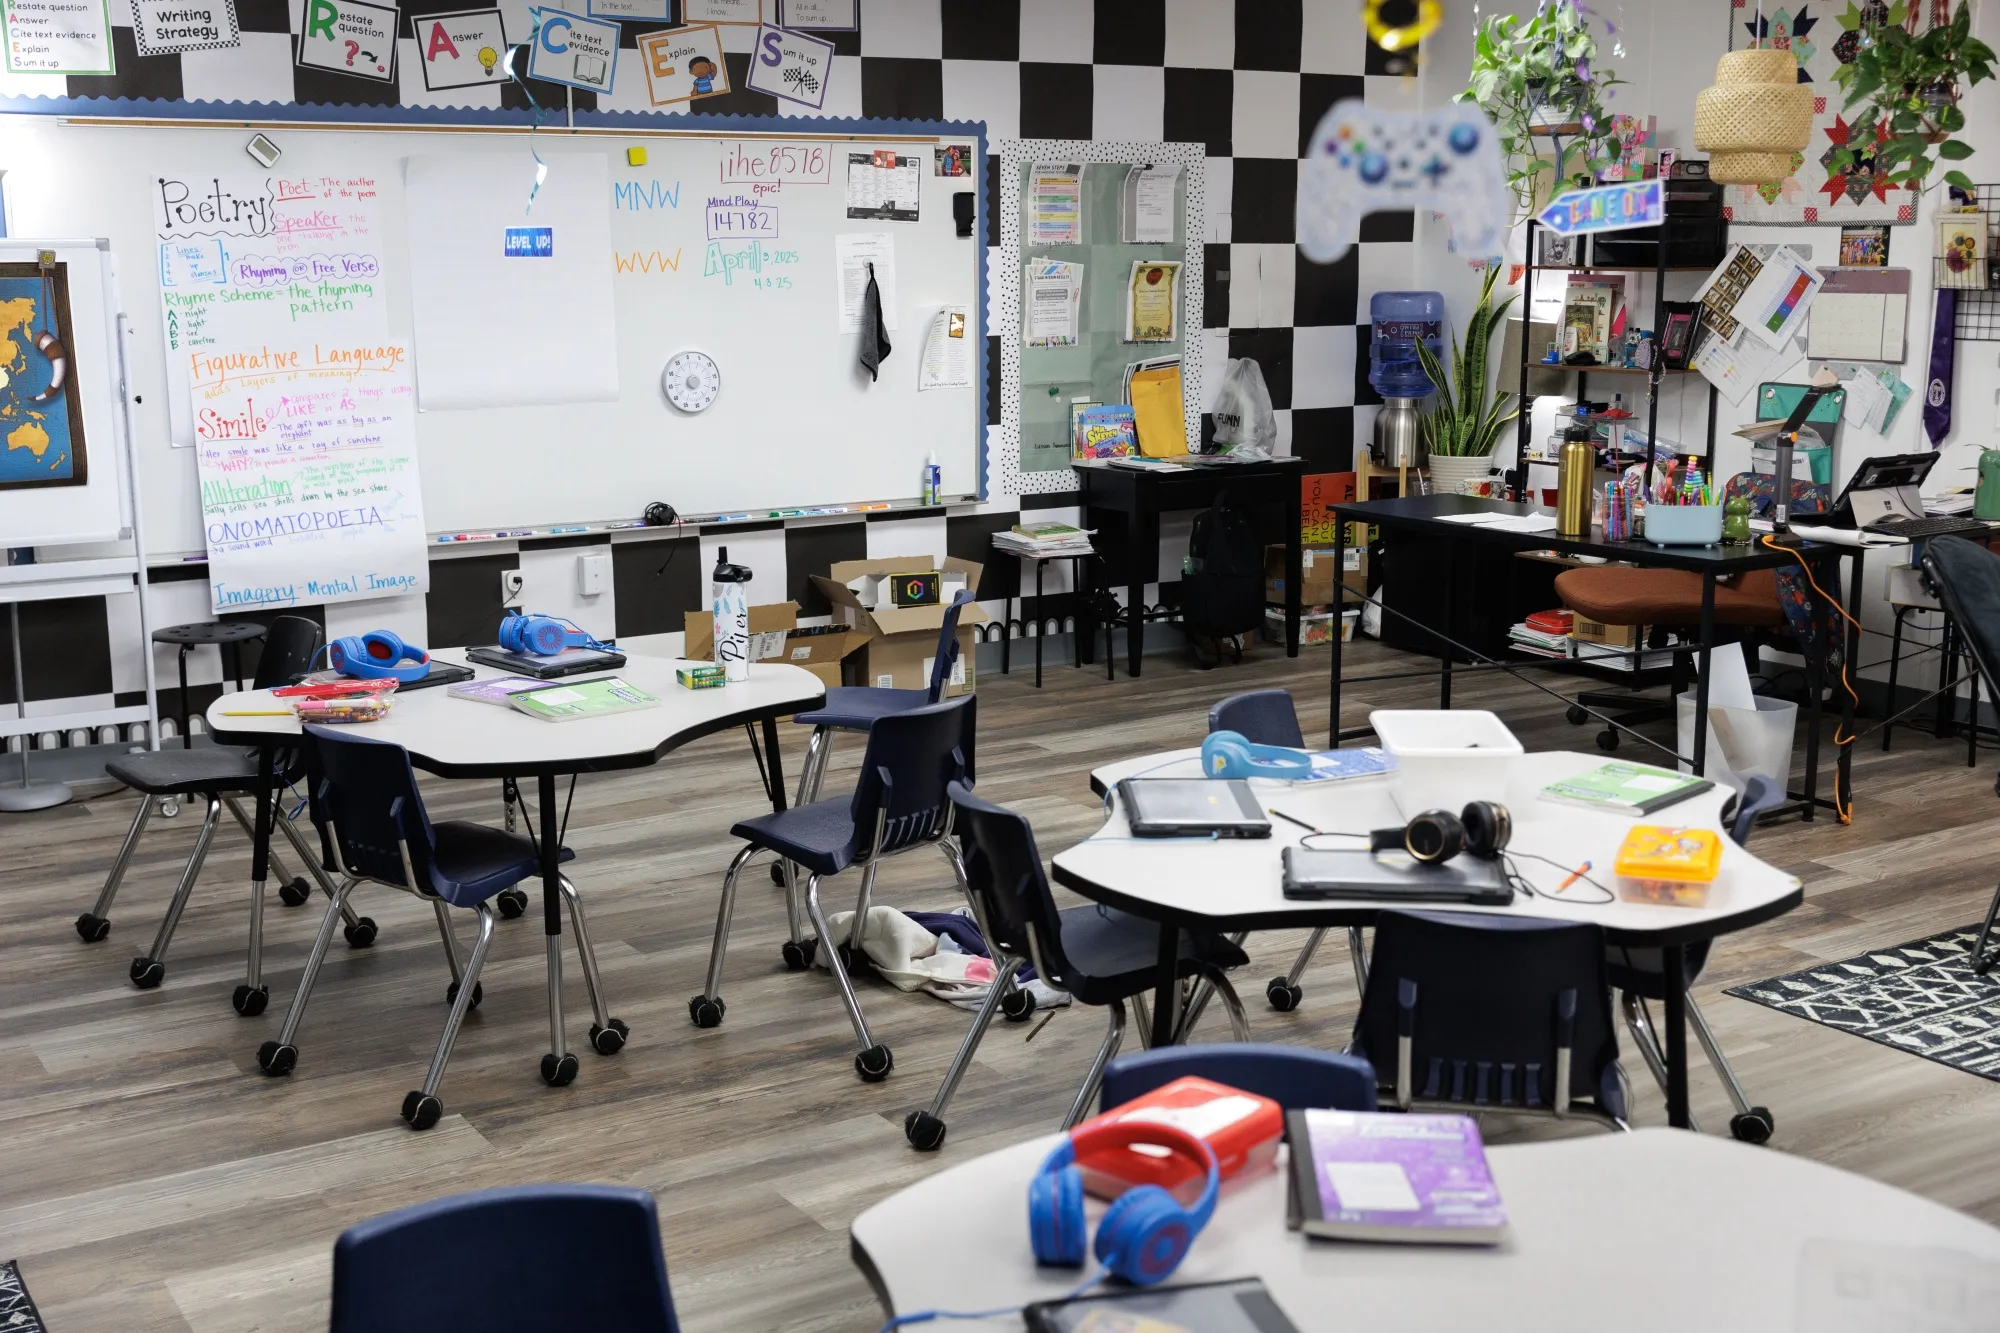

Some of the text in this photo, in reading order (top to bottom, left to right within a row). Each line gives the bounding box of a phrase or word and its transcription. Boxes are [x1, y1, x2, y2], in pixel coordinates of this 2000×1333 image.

[7, 0, 88, 14] Restate question
[9, 13, 49, 25] Answer
[157, 9, 212, 24] Writing
[10, 28, 97, 39] Cite text evidence
[156, 26, 219, 41] Strategy
[338, 23, 385, 38] question
[584, 34, 602, 46] text
[12, 42, 50, 55] Explain
[569, 42, 610, 57] evidence
[14, 57, 59, 69] Sum it up
[797, 52, 805, 60] it
[805, 55, 817, 66] up
[279, 178, 310, 198] Poet
[347, 178, 376, 188] author
[323, 188, 377, 201] of the poem
[615, 180, 680, 211] MNW
[752, 178, 781, 197] epic!
[159, 177, 267, 235] Poetry
[707, 195, 759, 211] Mind Play
[275, 210, 337, 235] Speaker
[714, 212, 772, 231] 14782
[506, 235, 552, 249] LEVEL UP!
[176, 246, 199, 257] Lines
[615, 247, 682, 274] WVW
[704, 240, 761, 286] April
[239, 264, 288, 285] Rhyming
[313, 260, 337, 275] Free
[341, 259, 375, 273] Verse
[164, 279, 374, 310] Rhyme Scheme the rhyming
[168, 309, 178, 321] A
[290, 299, 354, 323] pattern
[170, 320, 178, 331] A
[170, 330, 178, 343] B
[171, 340, 179, 350] B
[190, 344, 405, 391] Figurative Language
[358, 387, 385, 402] things
[286, 399, 357, 418] LIKE AS
[198, 398, 267, 439] Simile
[317, 418, 333, 428] was
[352, 415, 364, 428] big
[367, 416, 377, 424] as
[205, 447, 221, 459] Her
[254, 446, 270, 454] was
[276, 443, 292, 453] like
[203, 474, 293, 506] Alliteration
[204, 506, 227, 518] Sally
[229, 504, 247, 514] sells
[254, 502, 267, 510] sea
[274, 496, 296, 507] shells
[301, 493, 320, 503] down
[337, 488, 349, 498] the
[353, 487, 367, 497] sea
[1312, 478, 1323, 536] YOU CAN
[208, 505, 384, 544] ONOMATOPOEIA
[1322, 512, 1333, 540] YOU
[228, 540, 250, 551] sound
[254, 537, 273, 549] word
[213, 572, 418, 606] Imagery Mental Image
